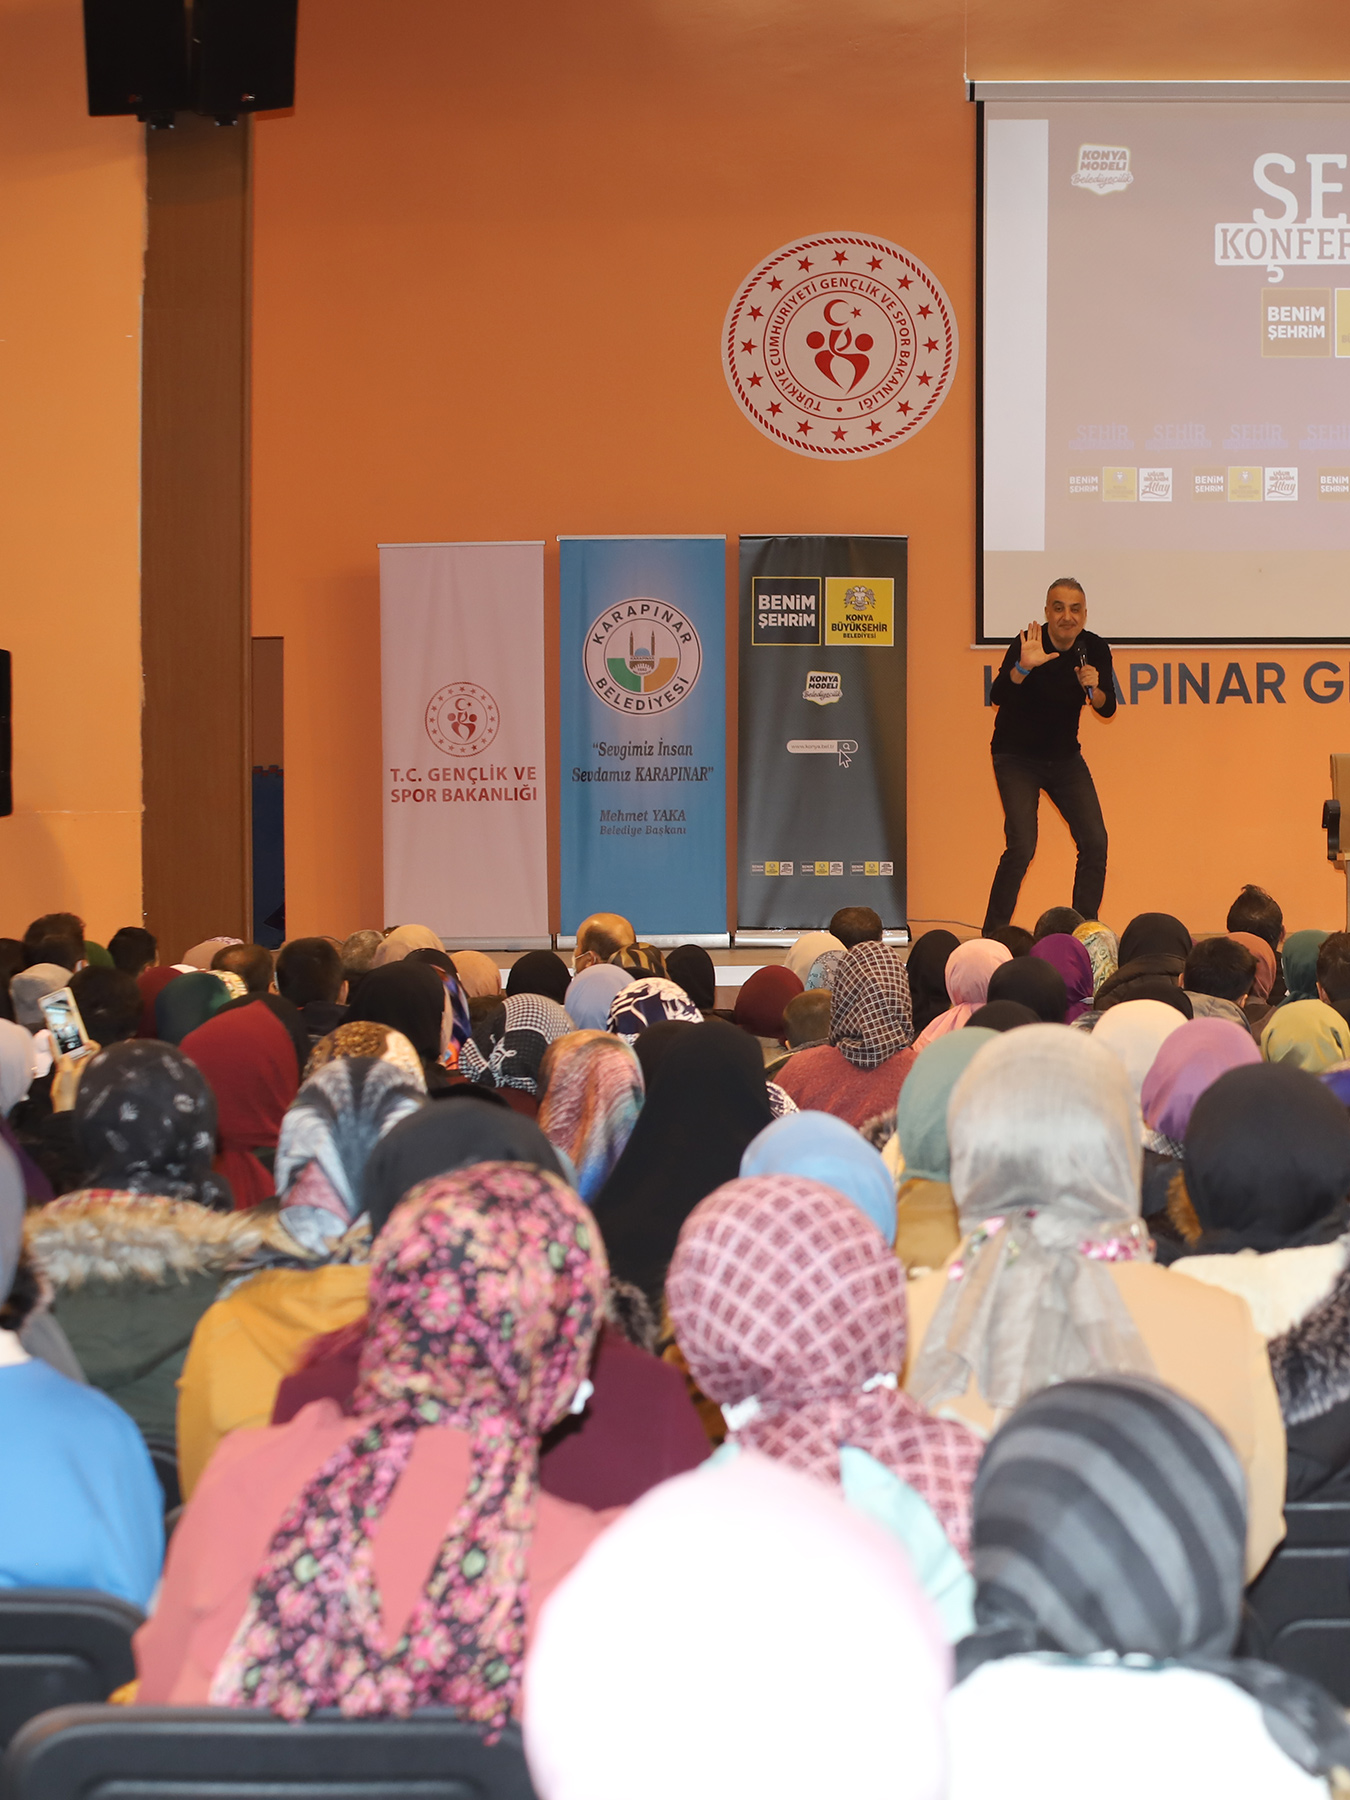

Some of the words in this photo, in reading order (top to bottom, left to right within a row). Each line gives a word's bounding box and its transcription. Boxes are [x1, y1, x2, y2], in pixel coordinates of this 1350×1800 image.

[1082, 150, 1127, 160] KONYA
[820, 277, 880, 297] GENÇLİK
[880, 293, 895, 311] VE
[769, 281, 817, 366] CUMHURİYETİ
[892, 311, 911, 346] SPOR
[774, 366, 822, 412] TÜRKİYE
[859, 351, 911, 411] BAKANLIĞI
[592, 604, 692, 645] KARAPINAR
[831, 621, 888, 633] BÜYÜKŞEHİR
[845, 614, 874, 622] KONYA
[595, 676, 689, 711] BELEDİYESİ
[658, 737, 693, 756] İnsan
[390, 768, 422, 782] T.C.
[428, 764, 508, 785] GENÇLİK
[514, 766, 537, 780] VE
[571, 767, 632, 782] Sevdamız
[391, 788, 437, 803] SPOR
[442, 784, 537, 802] BAKANLIĞI
[599, 809, 648, 822] Mehmet
[652, 809, 686, 821] YAKA
[599, 825, 642, 837] Belediye
[645, 825, 687, 836] Başkanı
